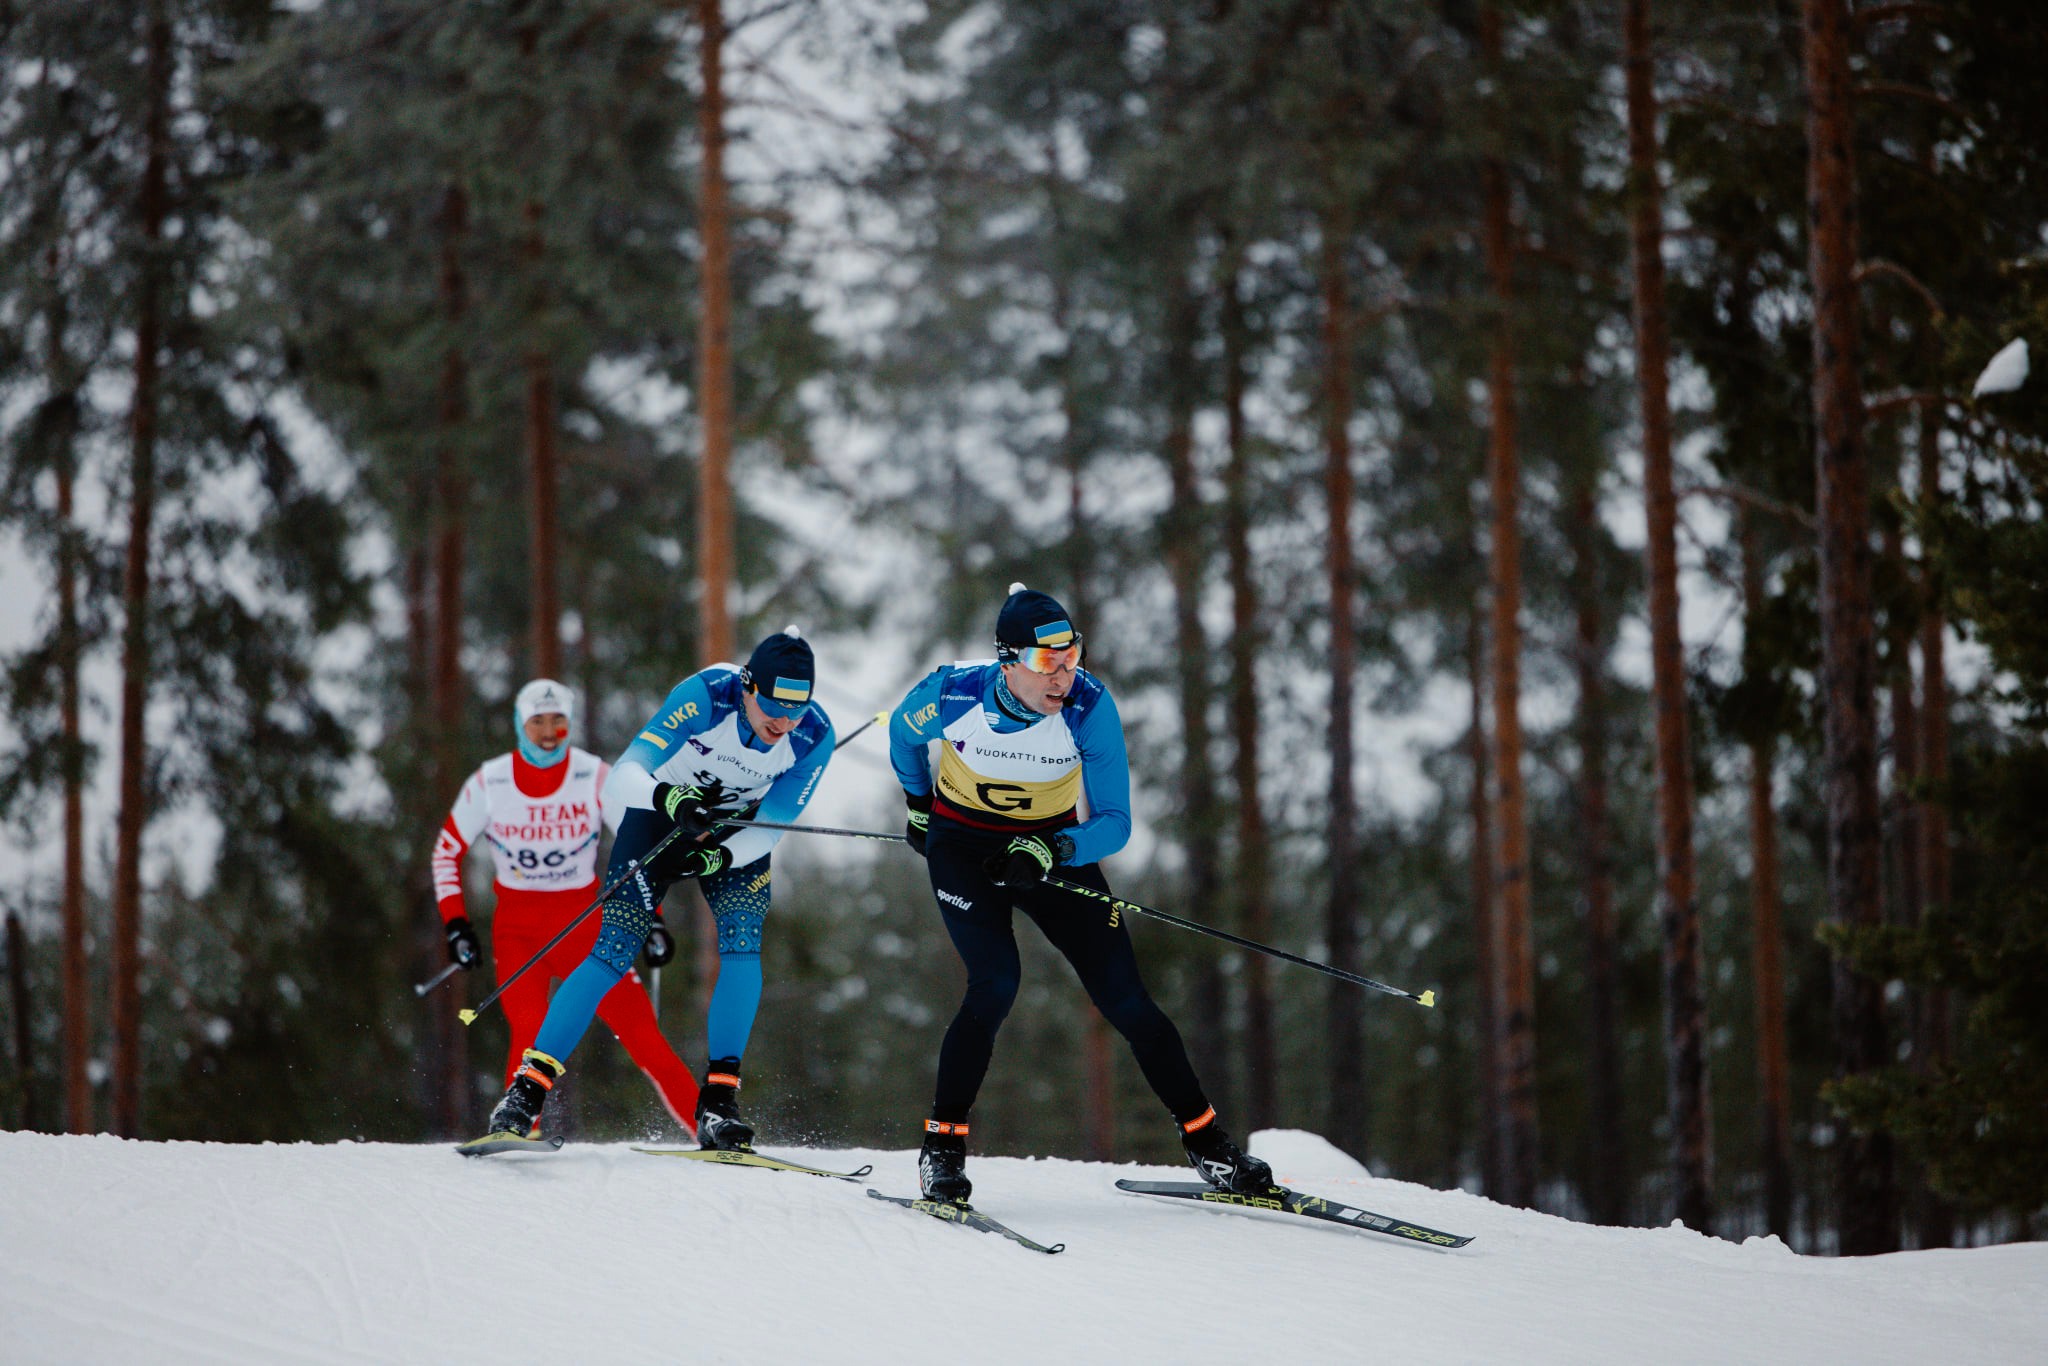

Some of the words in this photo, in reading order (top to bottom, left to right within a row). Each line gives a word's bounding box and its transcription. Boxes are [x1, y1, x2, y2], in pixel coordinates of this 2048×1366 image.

[663, 701, 700, 730] UKR
[913, 702, 940, 727] UKR
[975, 746, 1037, 762] VUOKATTI
[1040, 754, 1078, 765] SPORT
[717, 754, 763, 779] VUOKATTI
[526, 801, 591, 824] TEAM
[493, 822, 591, 842] SPORTIA
[518, 849, 566, 869] 86
[937, 888, 973, 911] sportful
[912, 1200, 958, 1221] FISCHER
[1202, 1191, 1283, 1212] FISCHER
[1392, 1225, 1456, 1246] FISCHER
